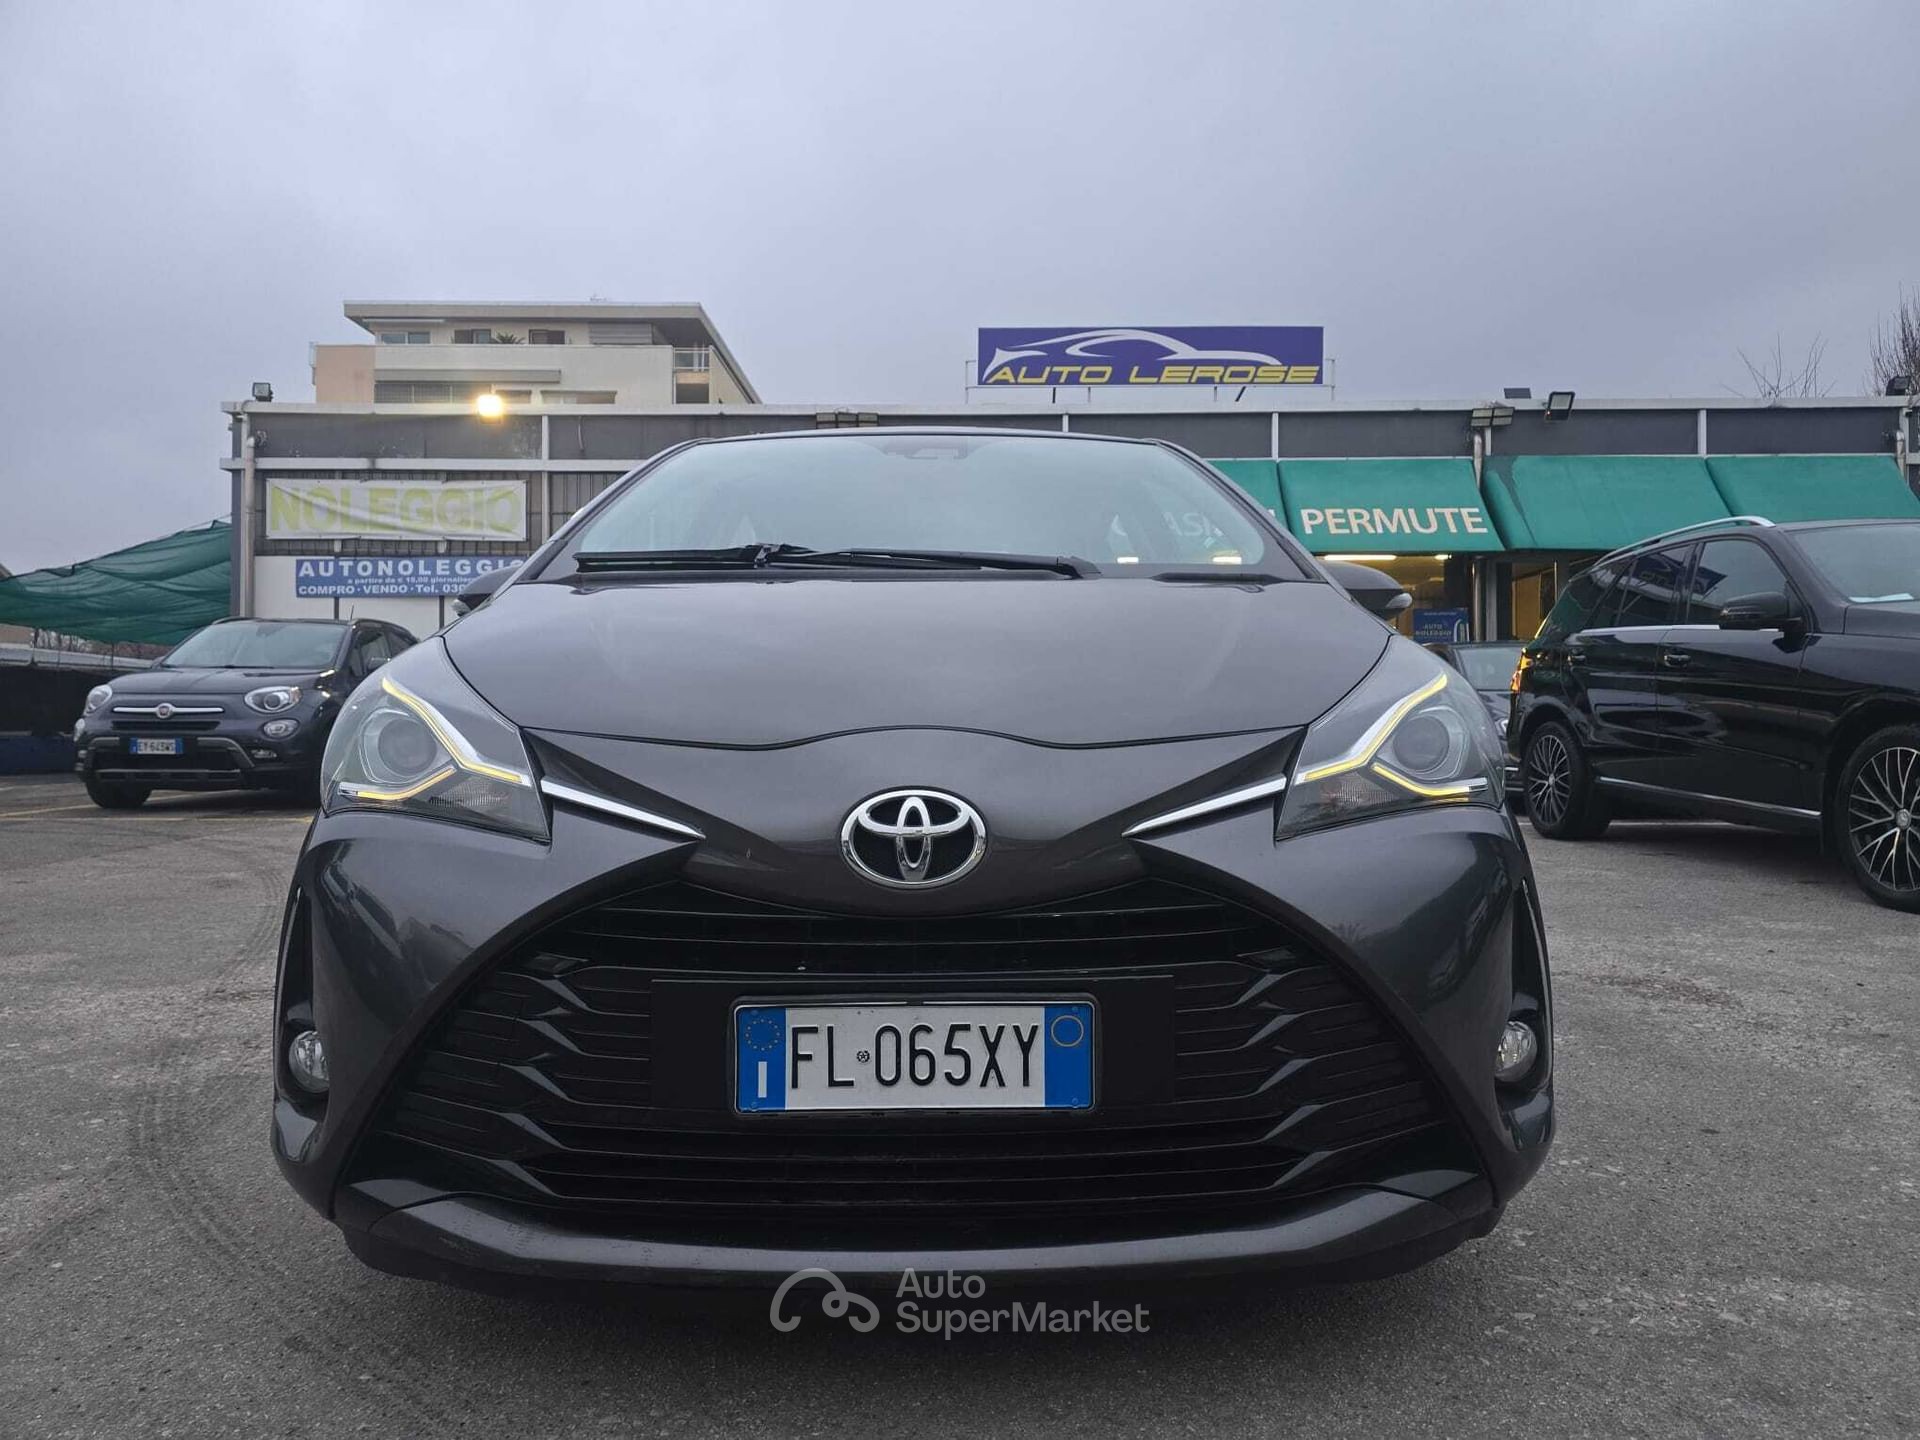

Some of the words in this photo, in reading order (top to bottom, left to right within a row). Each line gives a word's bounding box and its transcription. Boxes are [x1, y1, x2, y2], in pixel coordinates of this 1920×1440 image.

[986, 366, 1113, 384] AUTO
[1129, 366, 1320, 383] LEROSE
[270, 486, 522, 533] NOLEGGIO
[1302, 507, 1488, 535] PERMUTE
[298, 585, 355, 595] COMPRO
[363, 584, 408, 594] VENDO
[415, 584, 439, 593] Tel.
